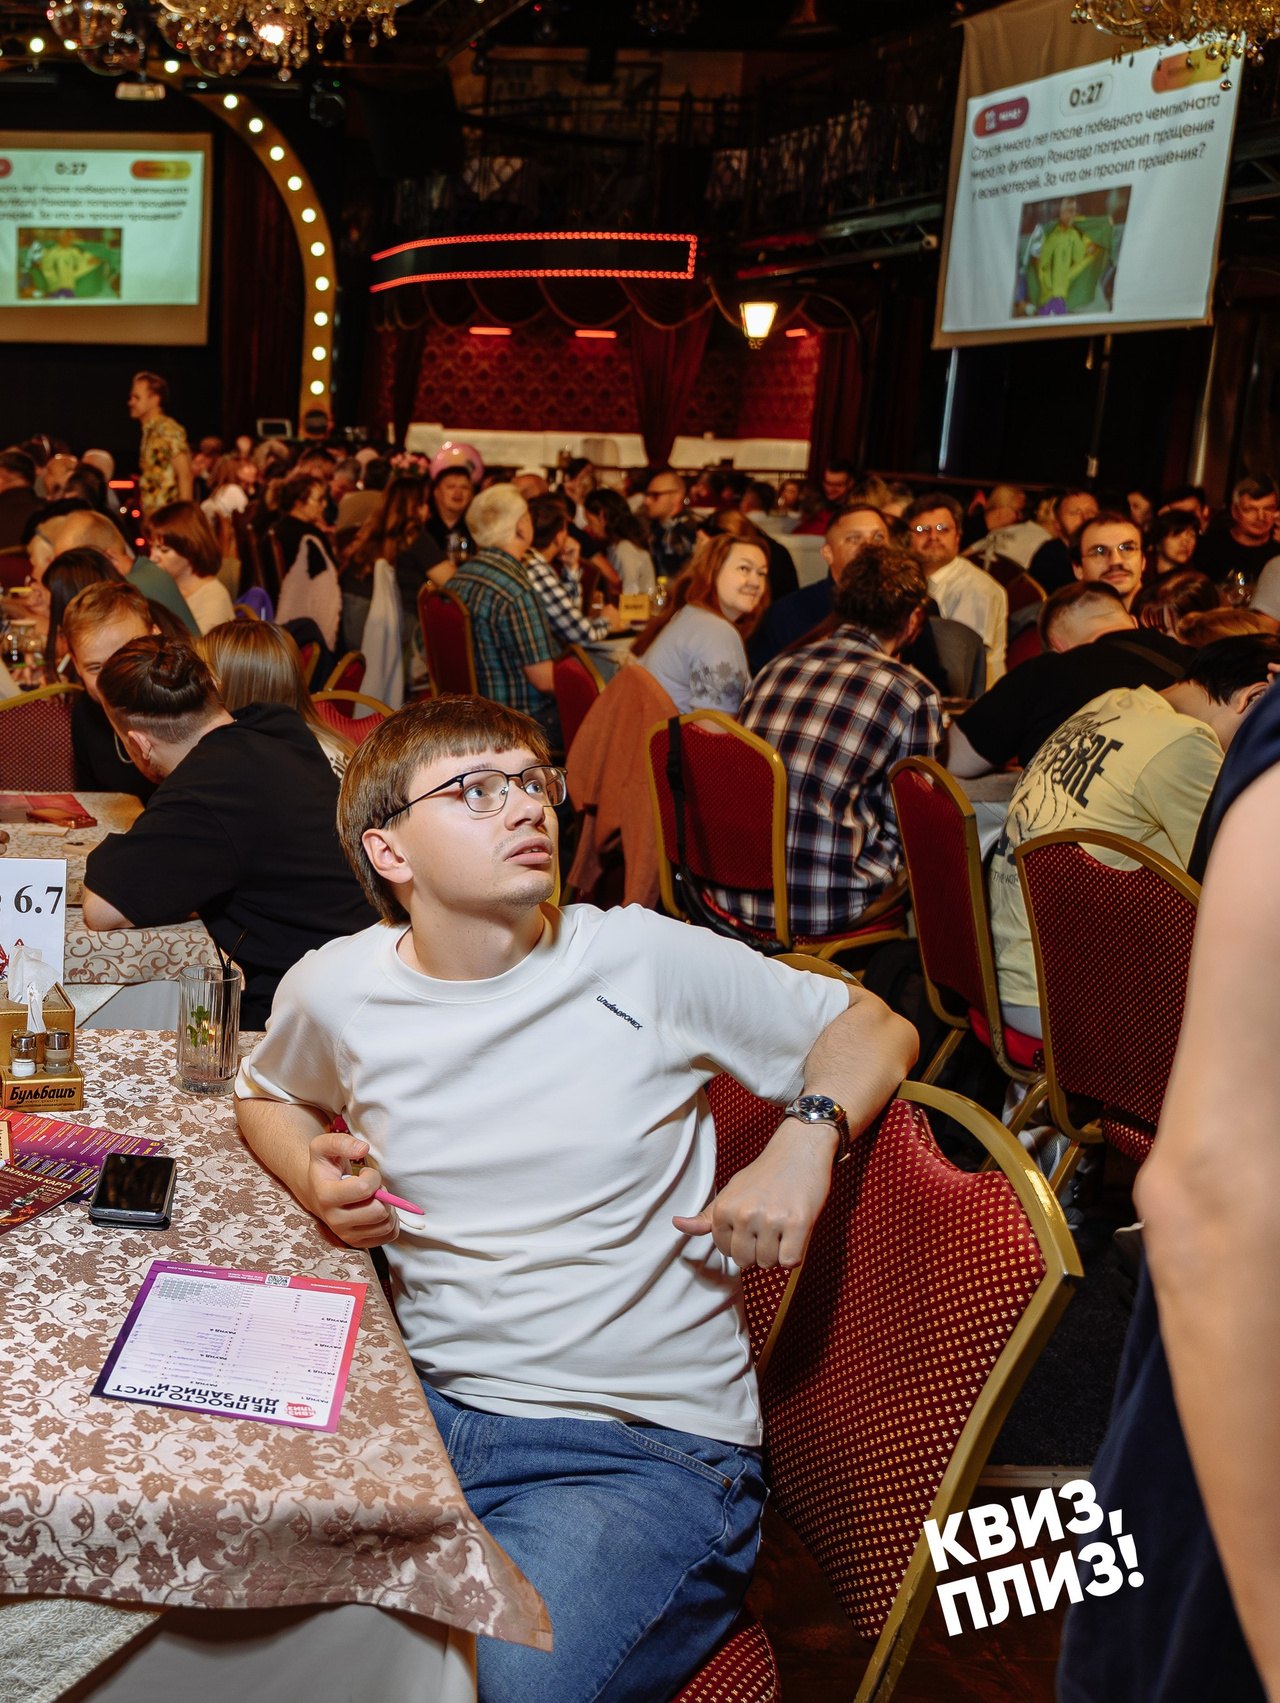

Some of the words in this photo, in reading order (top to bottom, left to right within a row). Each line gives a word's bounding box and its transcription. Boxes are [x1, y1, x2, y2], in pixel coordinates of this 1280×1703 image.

[1070, 82, 1104, 108] 0:27
[55, 161, 87, 175] 0:27
[14, 884, 64, 914] 6.7
[43, 1178, 72, 1190] КАРТА
[112, 1384, 165, 1397] ЛИСТ
[168, 1392, 248, 1410] ПРОСТО
[238, 1394, 280, 1406] ДЛЯ
[252, 1404, 277, 1415] НЕ
